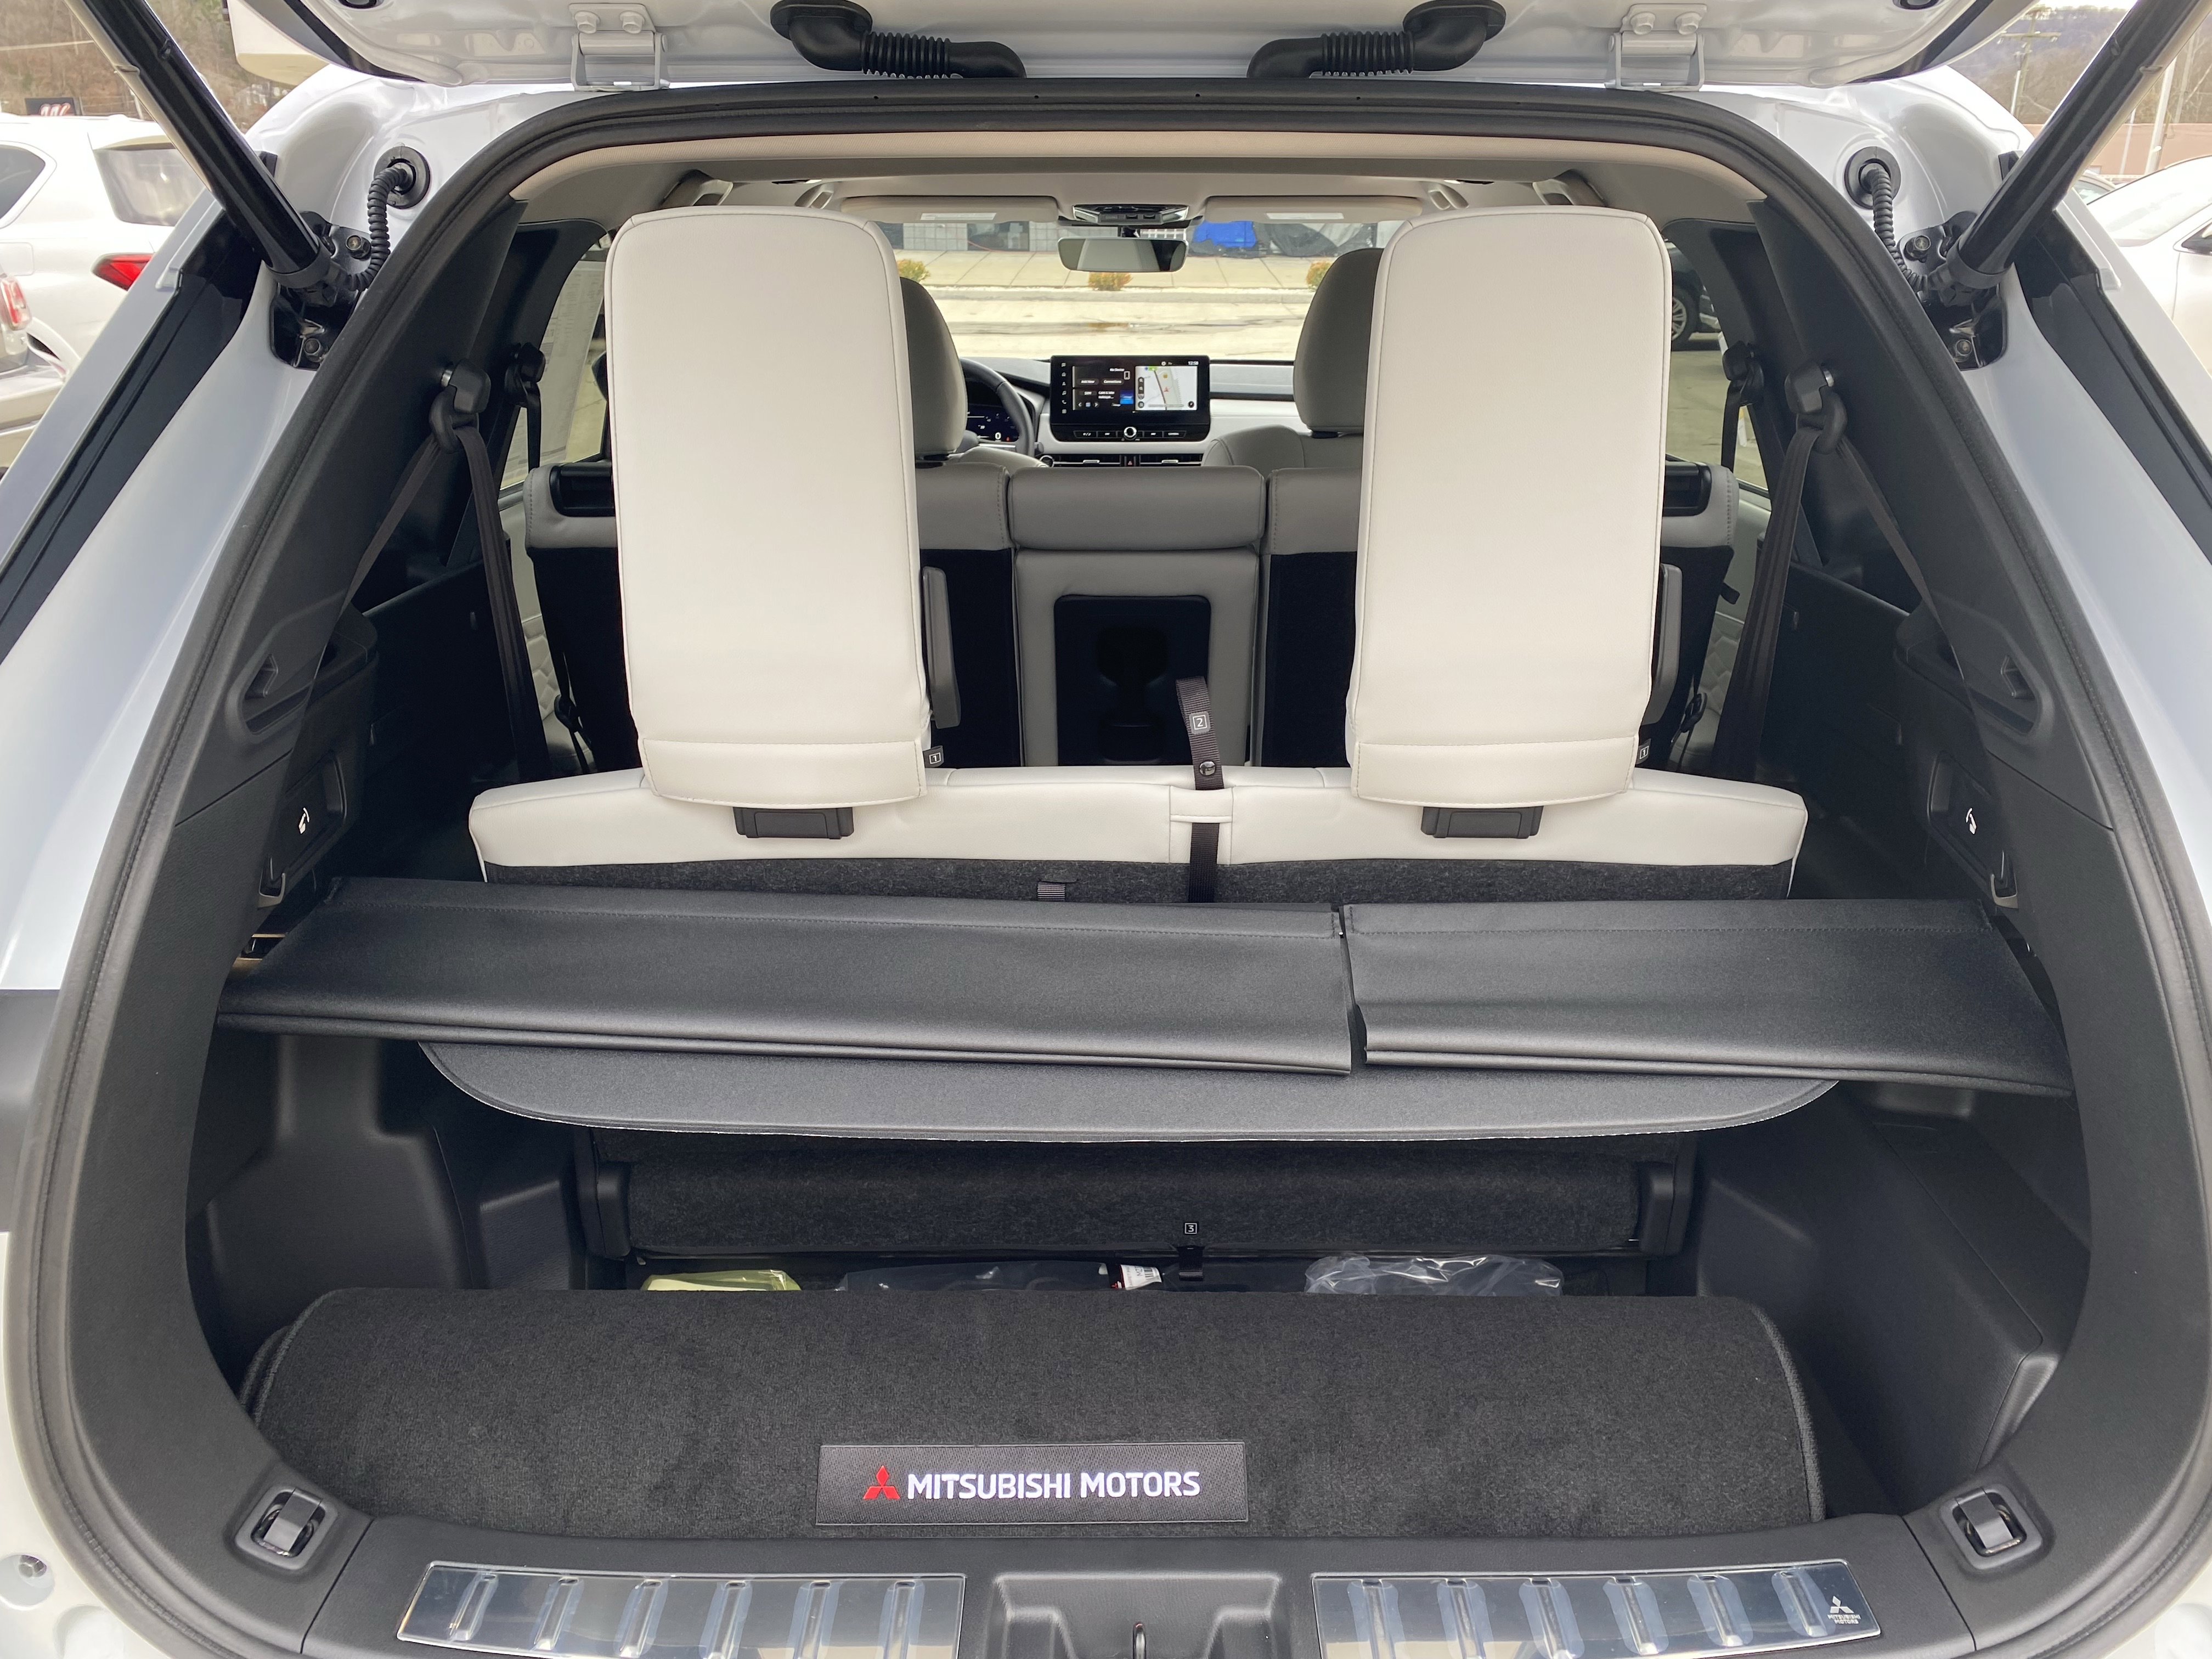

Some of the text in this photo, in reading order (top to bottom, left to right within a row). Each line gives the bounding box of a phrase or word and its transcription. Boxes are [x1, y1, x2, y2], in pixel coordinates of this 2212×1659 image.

[1195, 717, 1204, 727] 2
[907, 1471, 1201, 1500] MITSUBISHI MOTORS
